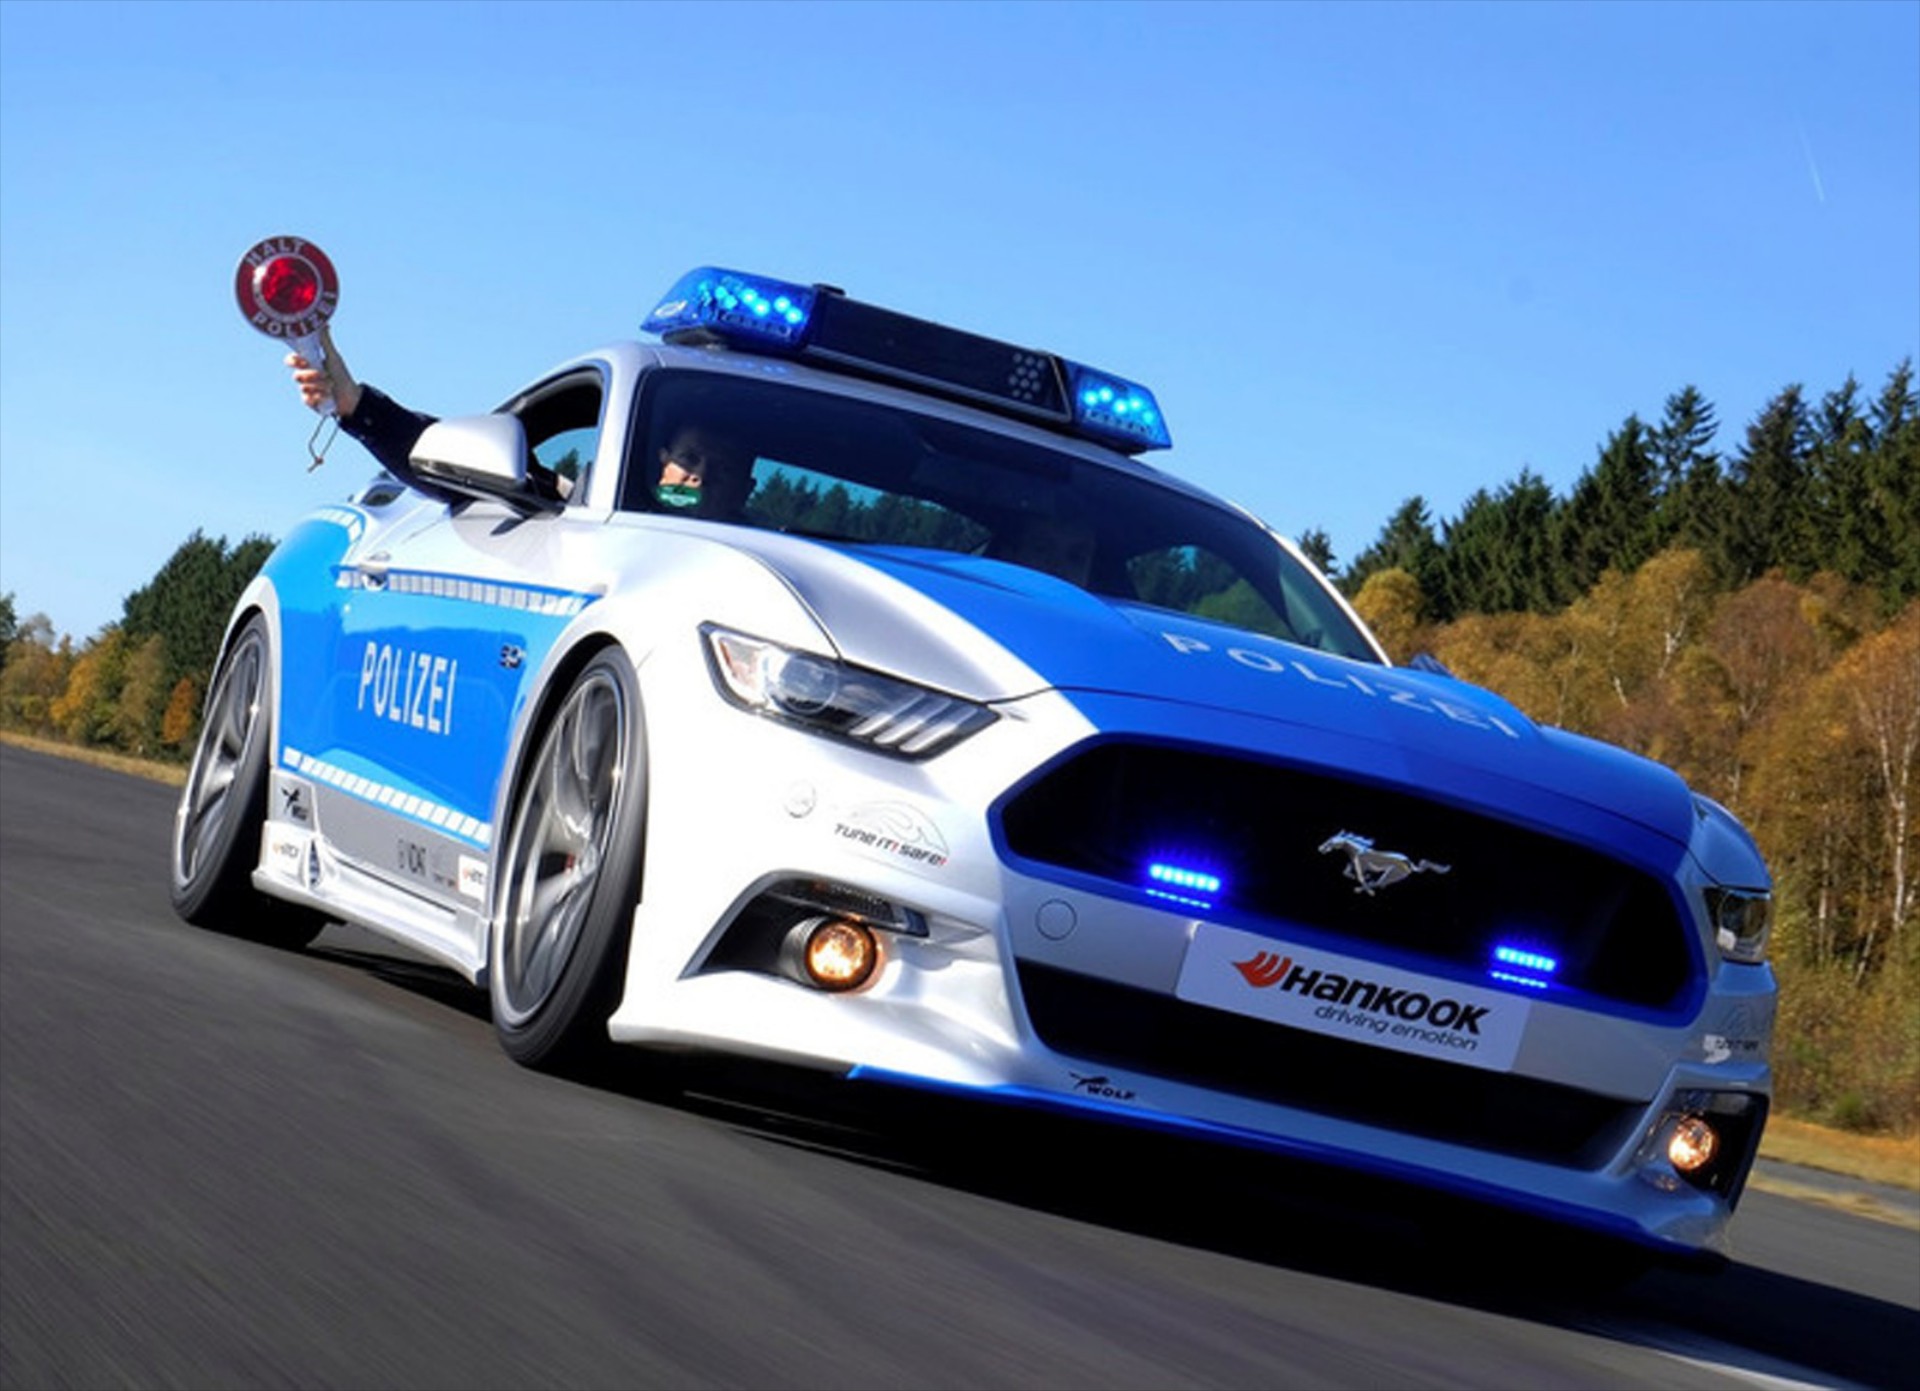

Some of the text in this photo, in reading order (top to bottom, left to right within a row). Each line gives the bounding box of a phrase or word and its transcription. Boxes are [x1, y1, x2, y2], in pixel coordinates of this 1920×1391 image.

[245, 239, 305, 267] HALT
[252, 291, 338, 338] POLIZEI
[357, 641, 457, 735] POLIZEI
[1162, 630, 1520, 739] POLIZEI
[1315, 1004, 1478, 1051] driving emotion
[1087, 1083, 1136, 1100] WOLF
